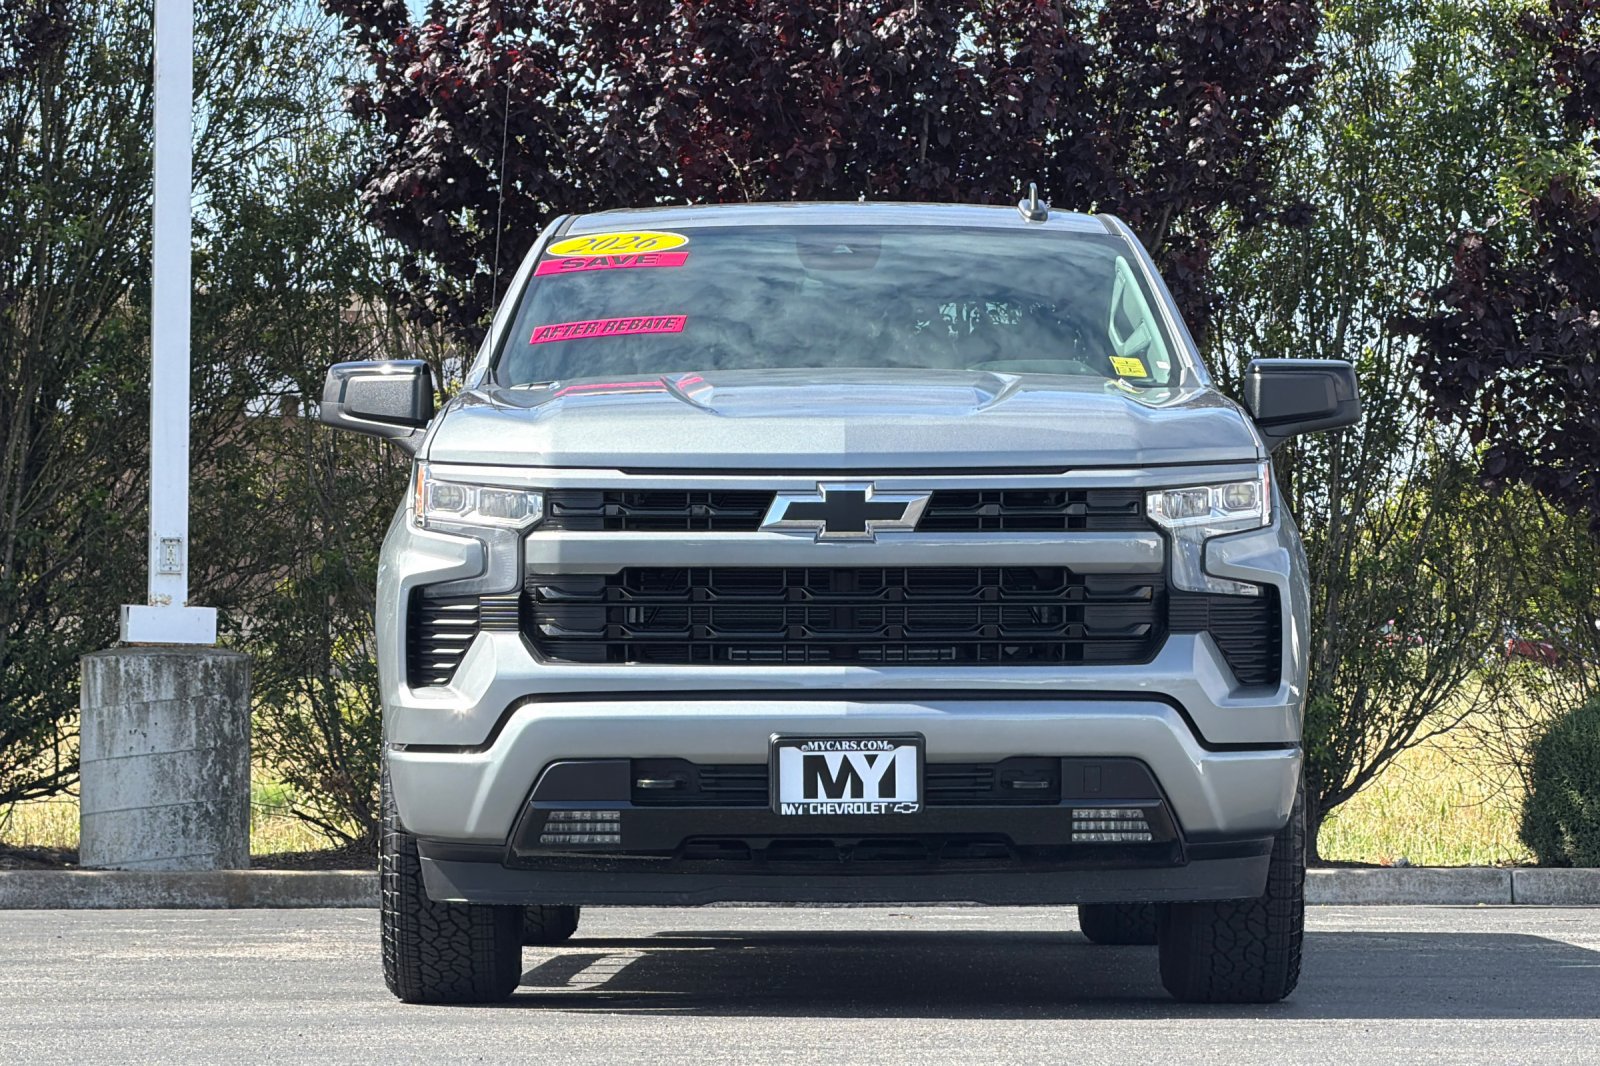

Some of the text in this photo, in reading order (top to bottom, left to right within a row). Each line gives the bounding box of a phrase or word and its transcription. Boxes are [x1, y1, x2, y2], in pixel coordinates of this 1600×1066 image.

[565, 235, 666, 253] 2026
[560, 254, 661, 269] SAVE
[536, 316, 679, 341] AFTER REBATE
[806, 741, 888, 751] MYCARS.COM
[803, 754, 896, 799] MY
[809, 803, 888, 815] CHEVROLET
